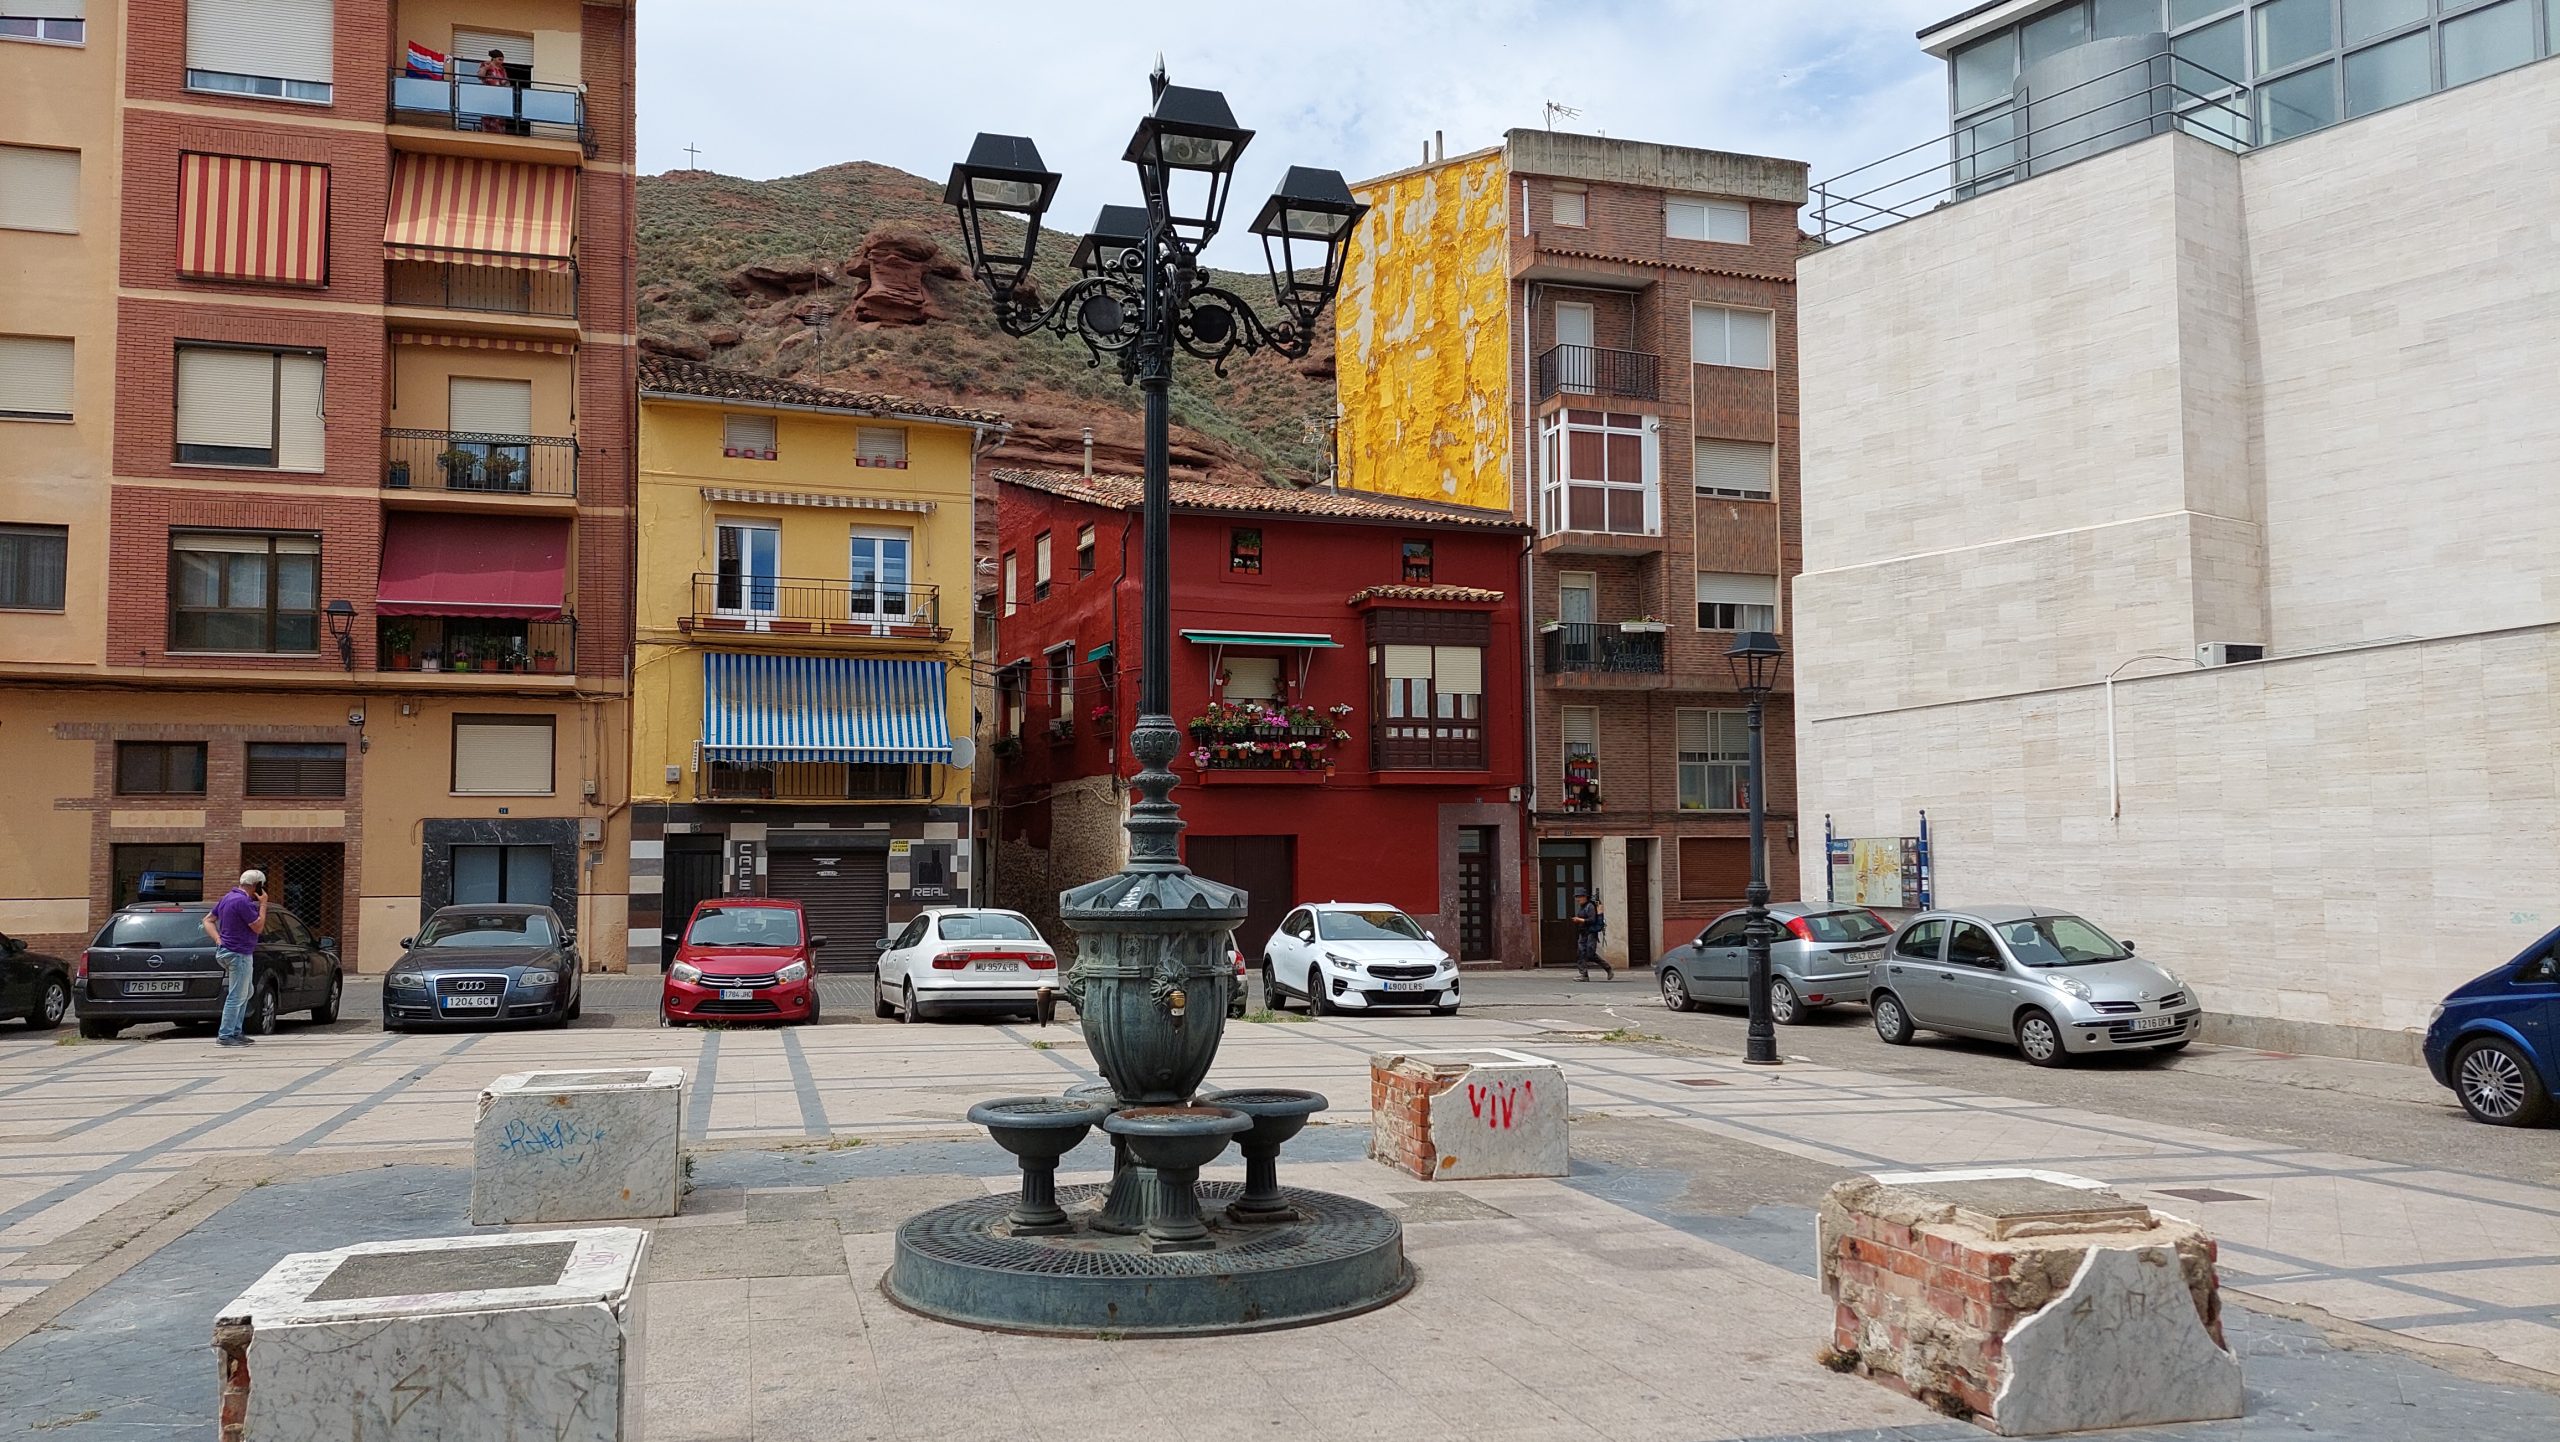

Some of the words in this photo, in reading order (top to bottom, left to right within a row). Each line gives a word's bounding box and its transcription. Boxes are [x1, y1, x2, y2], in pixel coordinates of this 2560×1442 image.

[739, 843, 752, 890] CAFE
[912, 887, 949, 897] REAL
[131, 982, 157, 991] 7615
[160, 981, 181, 991] GPR
[1388, 982, 1407, 990] 4900
[1408, 982, 1423, 990] LRS
[450, 997, 473, 1006] 1204
[2138, 1019, 2157, 1029] 1216
